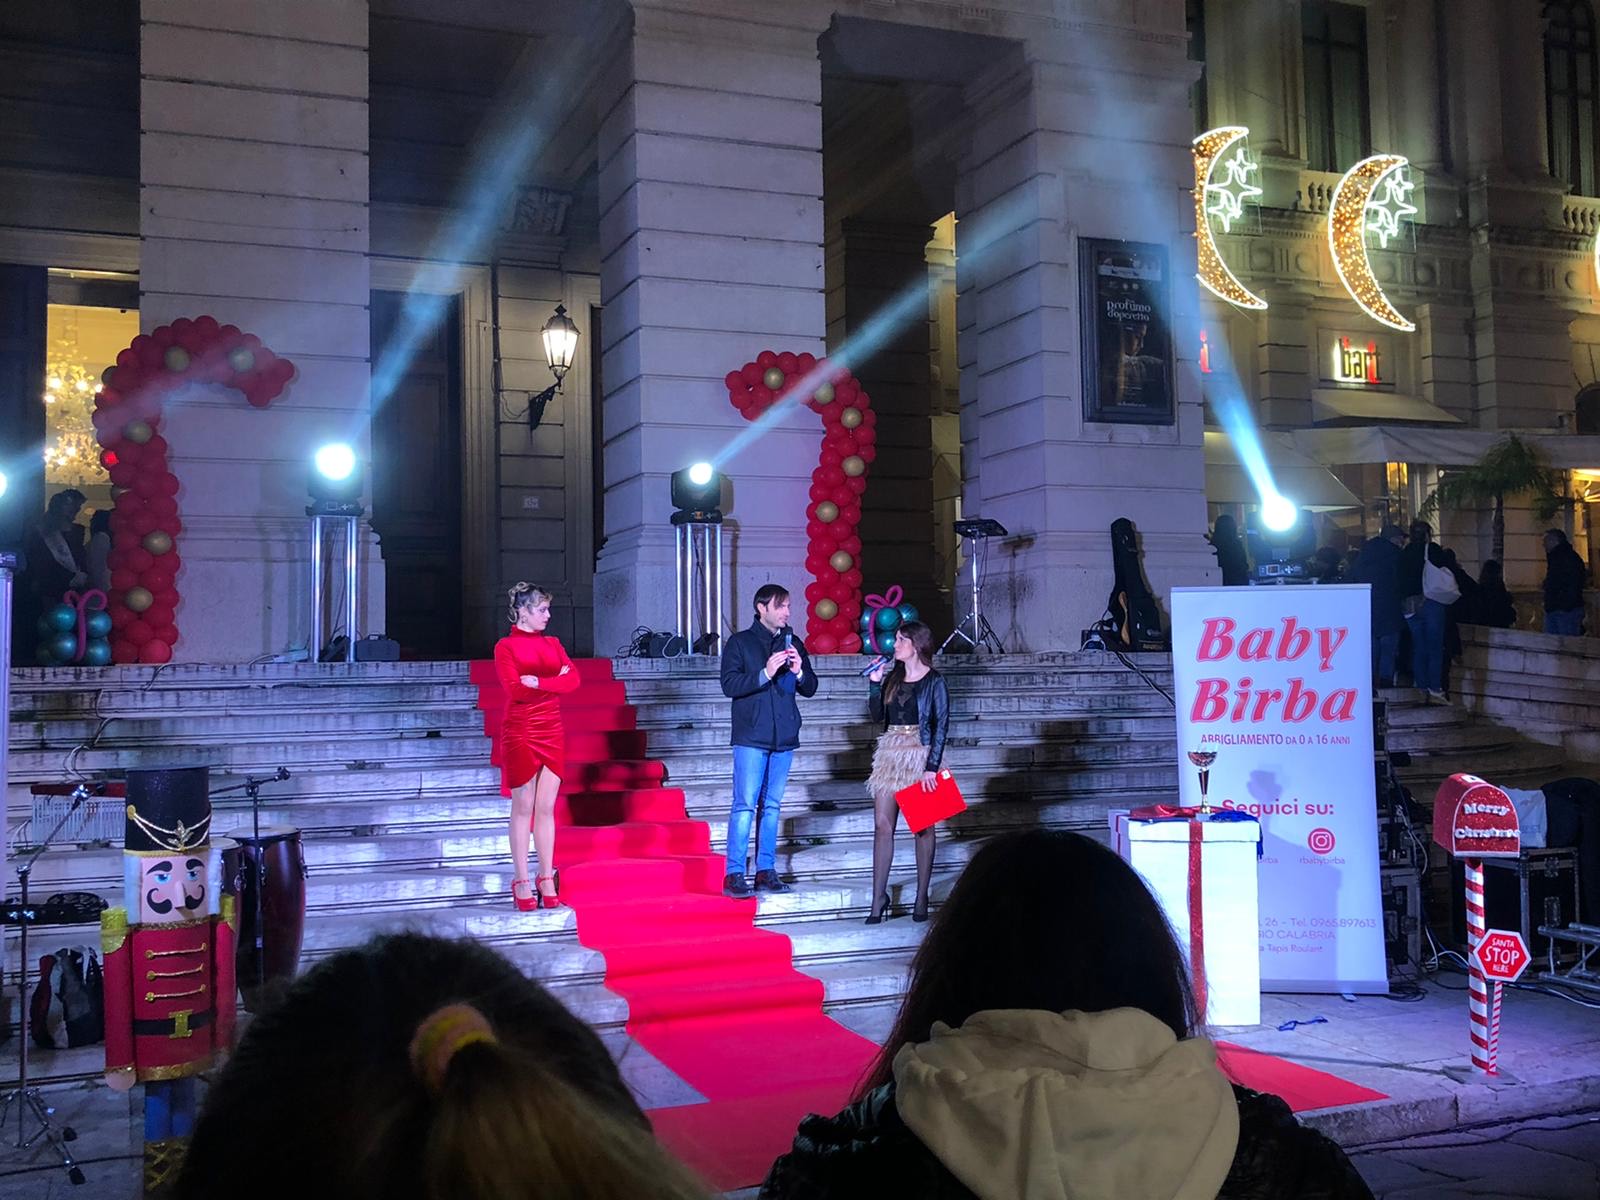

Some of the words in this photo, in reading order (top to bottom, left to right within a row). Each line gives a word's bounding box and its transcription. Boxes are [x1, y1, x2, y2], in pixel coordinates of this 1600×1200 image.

[1195, 616, 1349, 672] Baby
[1190, 677, 1359, 723] Birba
[1285, 735, 1298, 745] DA
[1299, 733, 1306, 745] 0
[1307, 736, 1314, 745] A
[1316, 733, 1329, 745] 16
[1330, 735, 1351, 745] ANNI
[1222, 798, 1299, 817] Seguici
[1304, 803, 1334, 815] su:
[1463, 803, 1510, 816] Merry
[1264, 917, 1278, 927] 26
[1276, 930, 1336, 940] CALABRIA
[1492, 937, 1515, 948] SANTA
[1484, 945, 1520, 966] STOP
[1492, 963, 1509, 973] HERE
